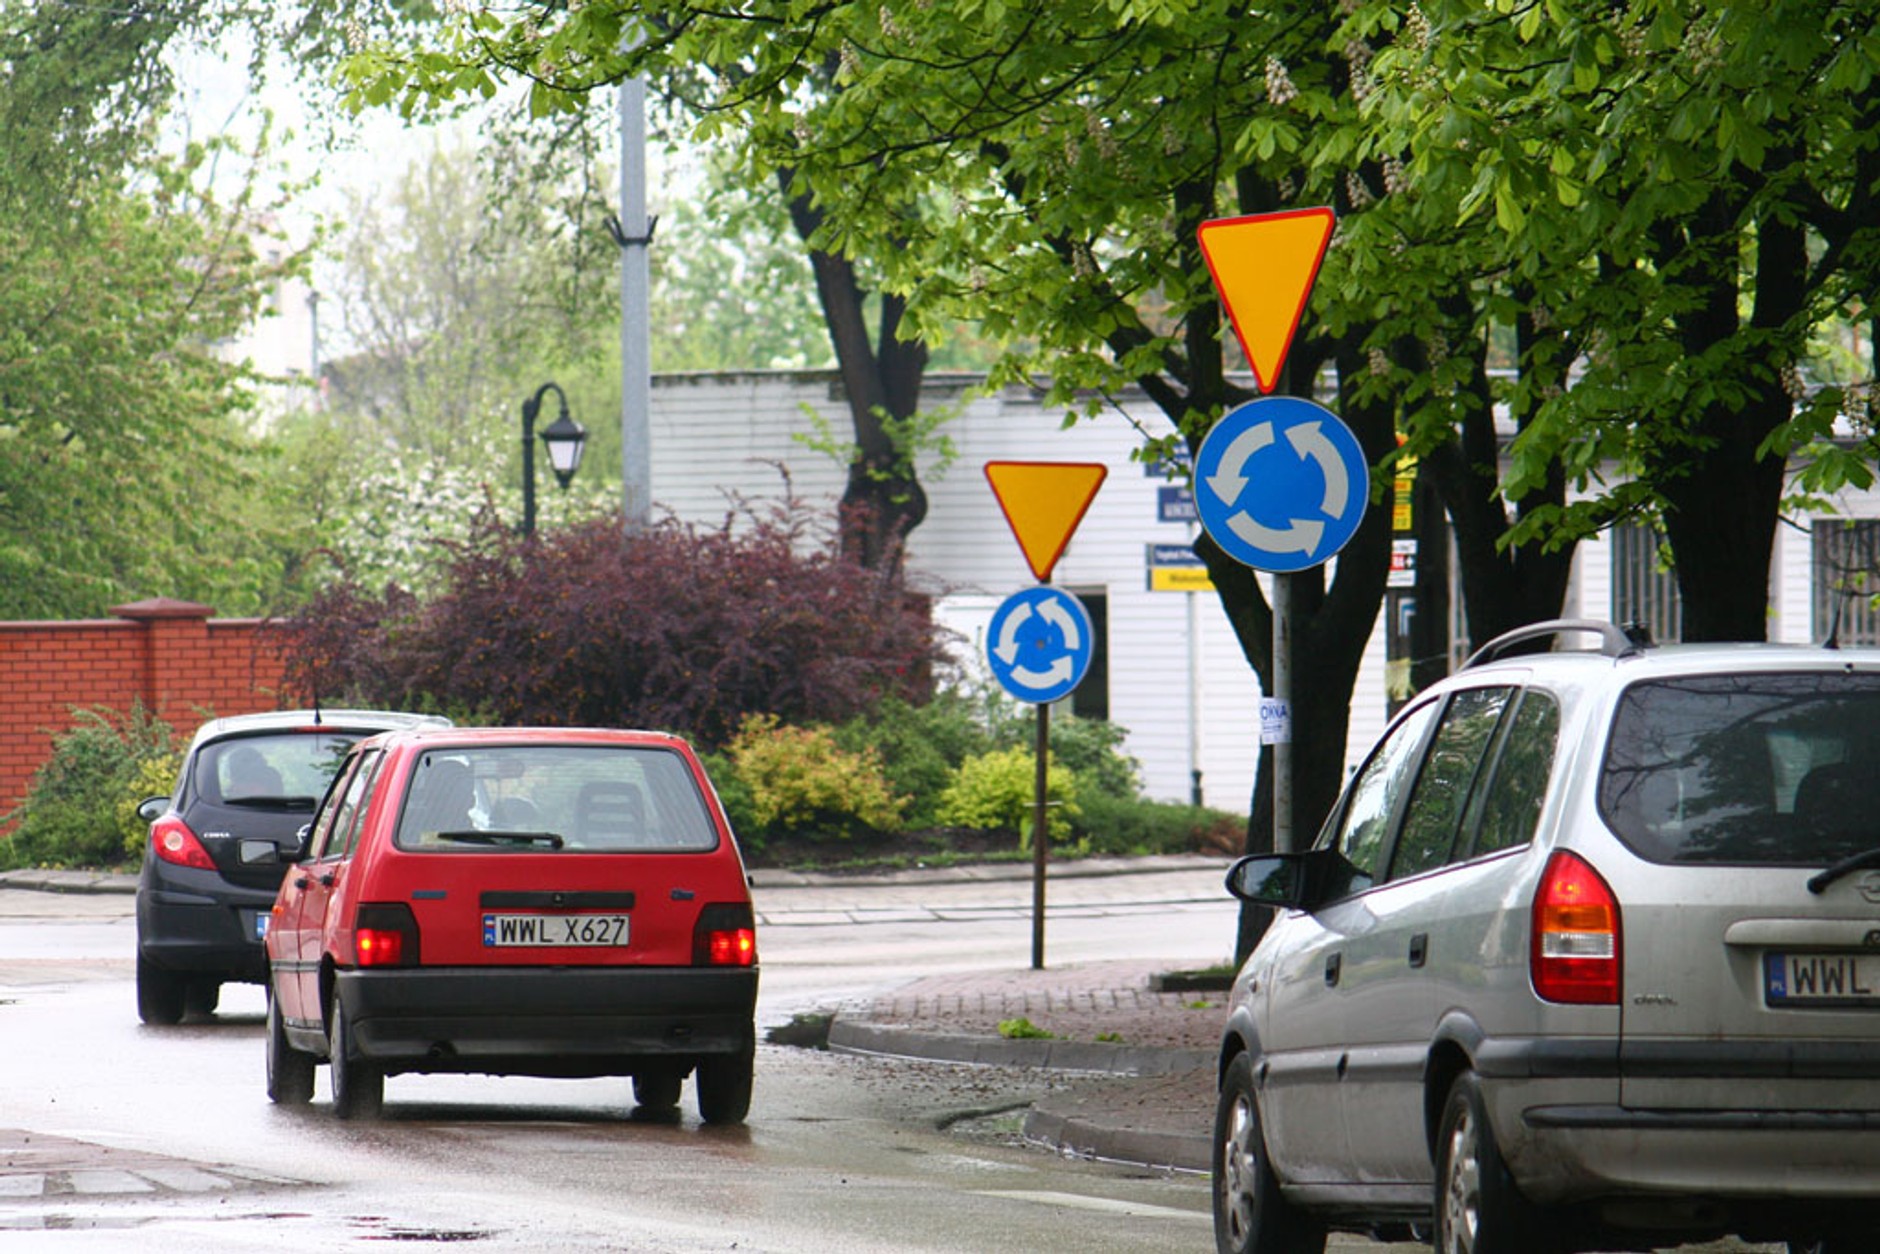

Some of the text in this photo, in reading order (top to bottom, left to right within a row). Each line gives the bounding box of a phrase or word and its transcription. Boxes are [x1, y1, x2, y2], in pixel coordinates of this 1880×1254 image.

[500, 917, 626, 945] WWL X627
[1792, 957, 1871, 995] WWL
